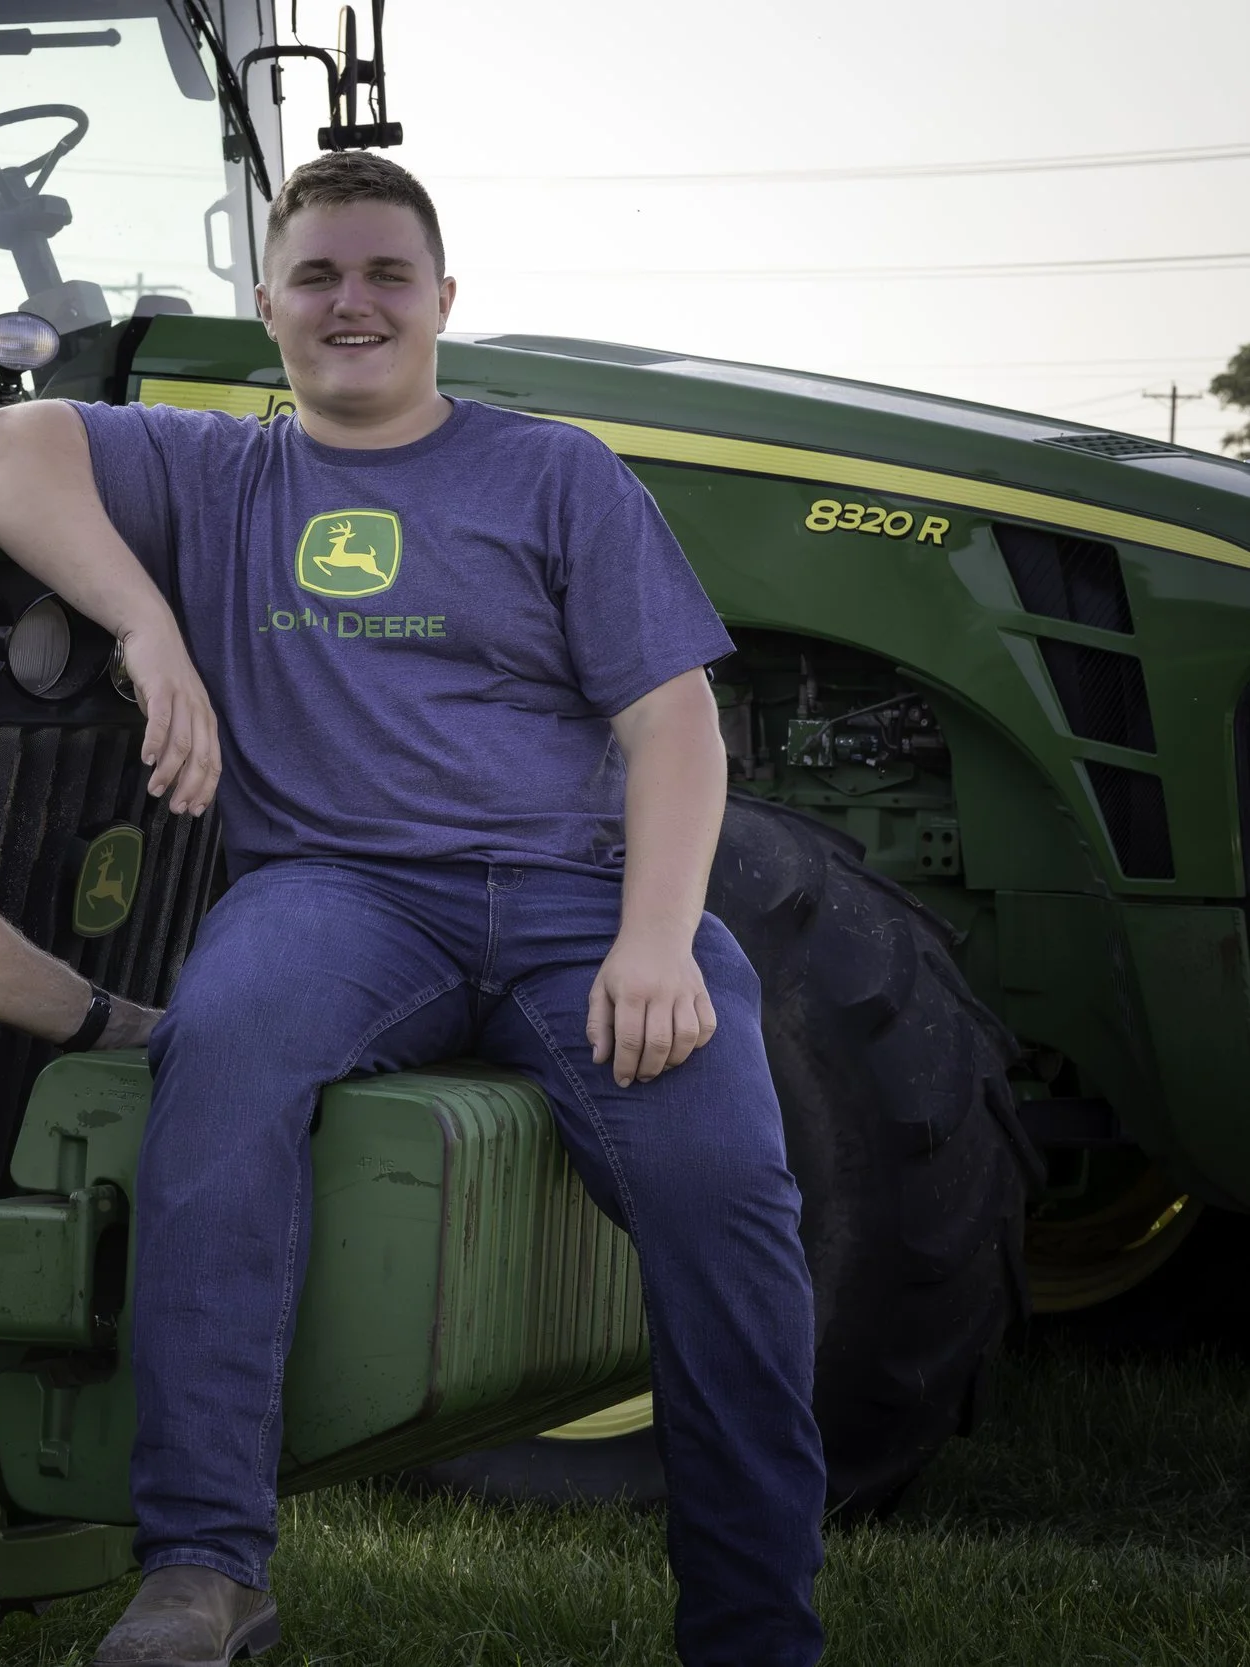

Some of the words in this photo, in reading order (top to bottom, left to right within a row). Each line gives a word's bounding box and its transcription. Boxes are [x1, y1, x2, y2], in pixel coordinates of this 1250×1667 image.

[805, 499, 914, 538] 8320
[916, 515, 950, 546] R
[337, 611, 447, 638] DEERE
